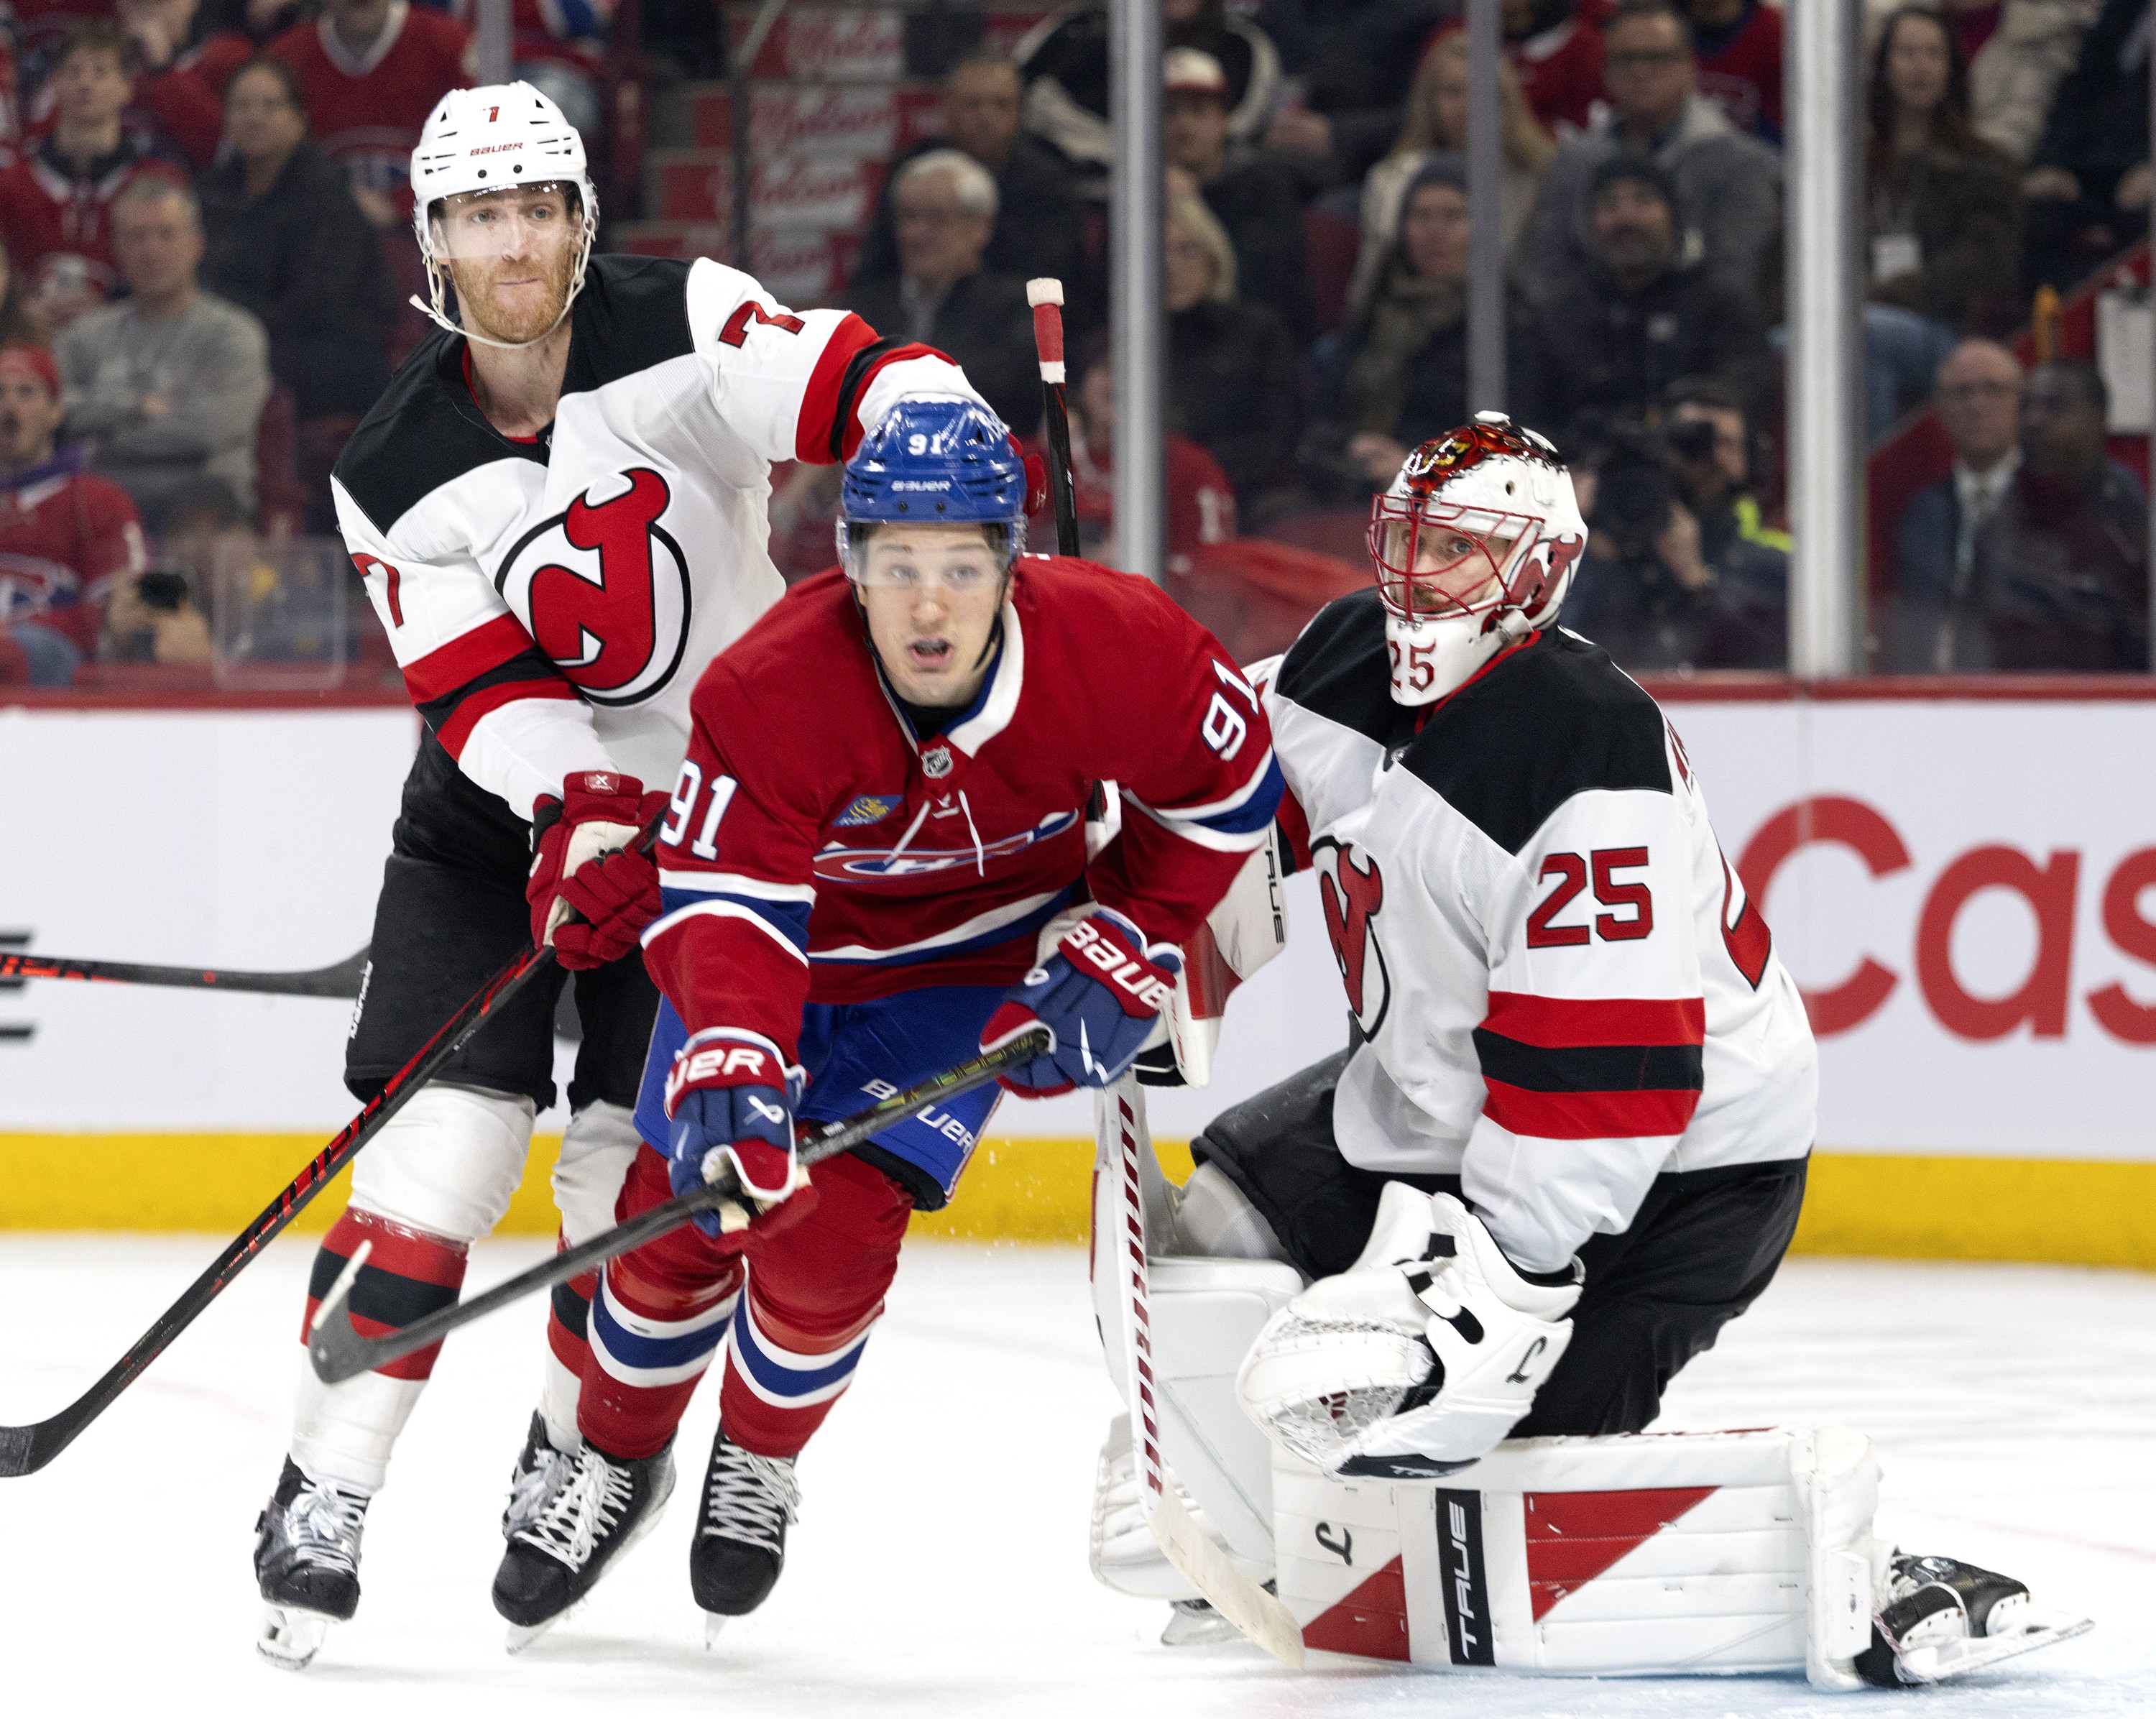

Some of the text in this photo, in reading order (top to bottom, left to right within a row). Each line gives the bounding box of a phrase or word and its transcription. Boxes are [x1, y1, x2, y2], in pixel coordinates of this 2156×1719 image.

[717, 300, 806, 349] 7
[907, 433, 944, 457] 91
[349, 551, 405, 630] 7
[1199, 657, 1260, 762] 91
[658, 757, 740, 862] 91
[1526, 845, 1654, 950] 25
[1448, 1500, 1478, 1661] TRUE
